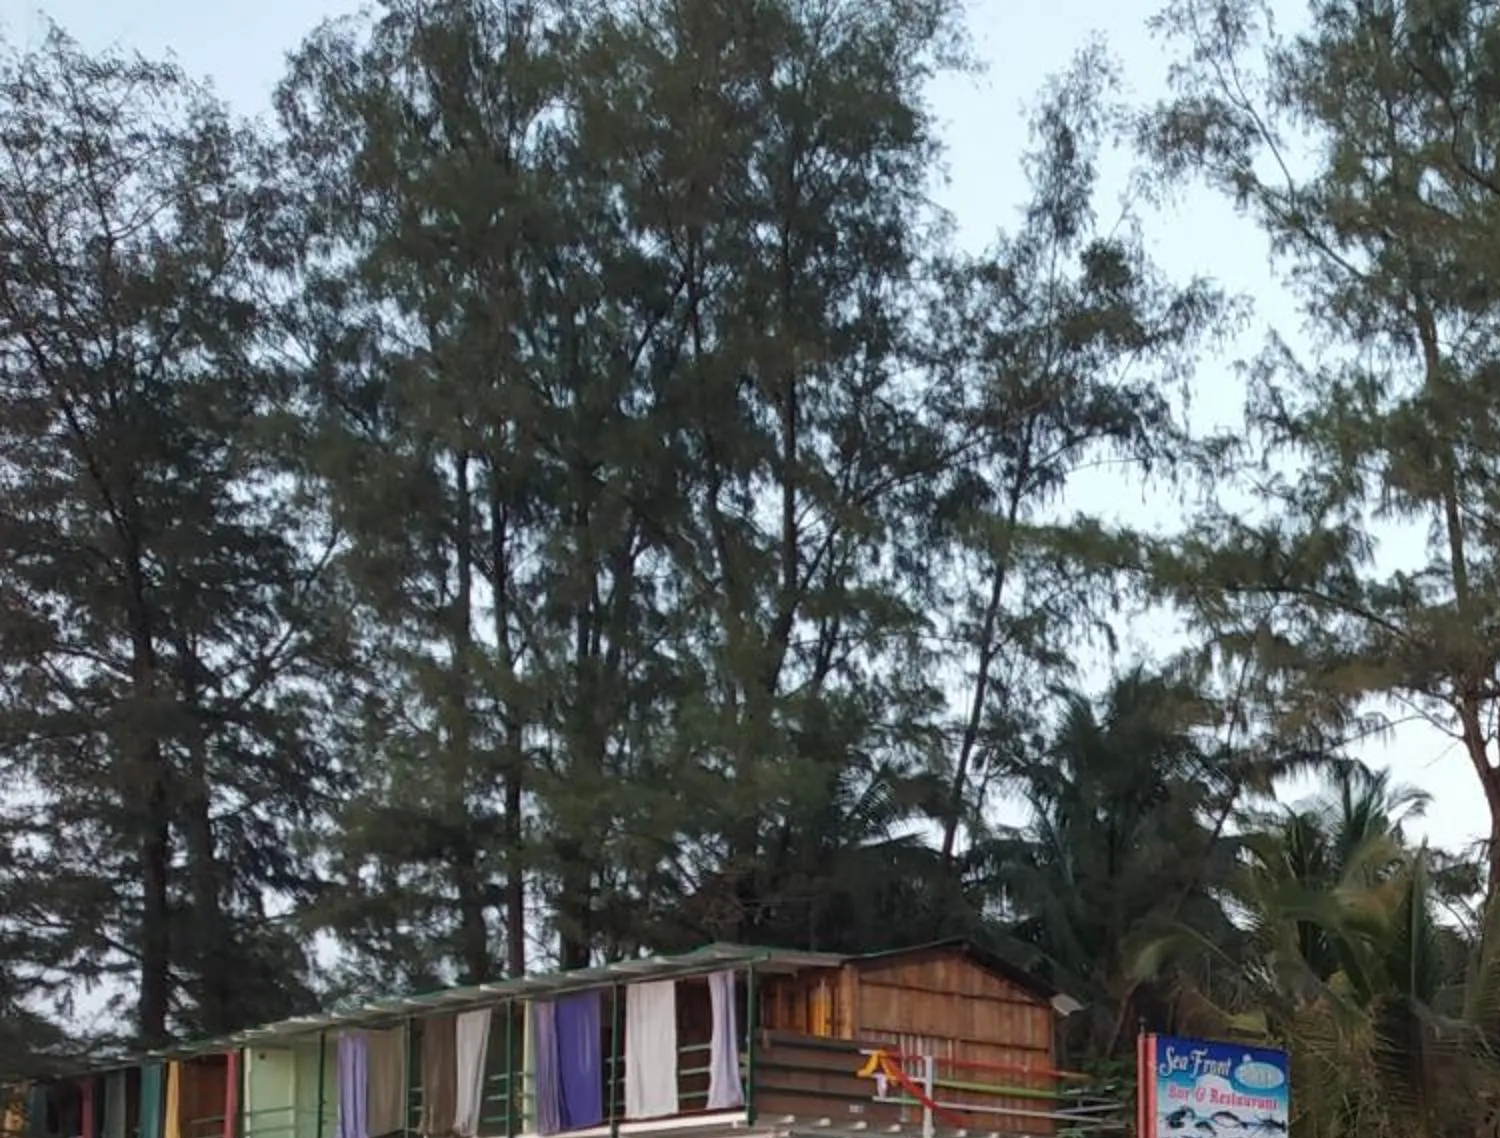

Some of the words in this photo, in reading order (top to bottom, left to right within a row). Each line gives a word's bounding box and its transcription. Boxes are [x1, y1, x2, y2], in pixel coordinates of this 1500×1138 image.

[1159, 1046, 1190, 1077] Sea
[1190, 1048, 1232, 1078] Front
[1167, 1084, 1190, 1102] Bar
[1209, 1088, 1279, 1111] Restaurant
